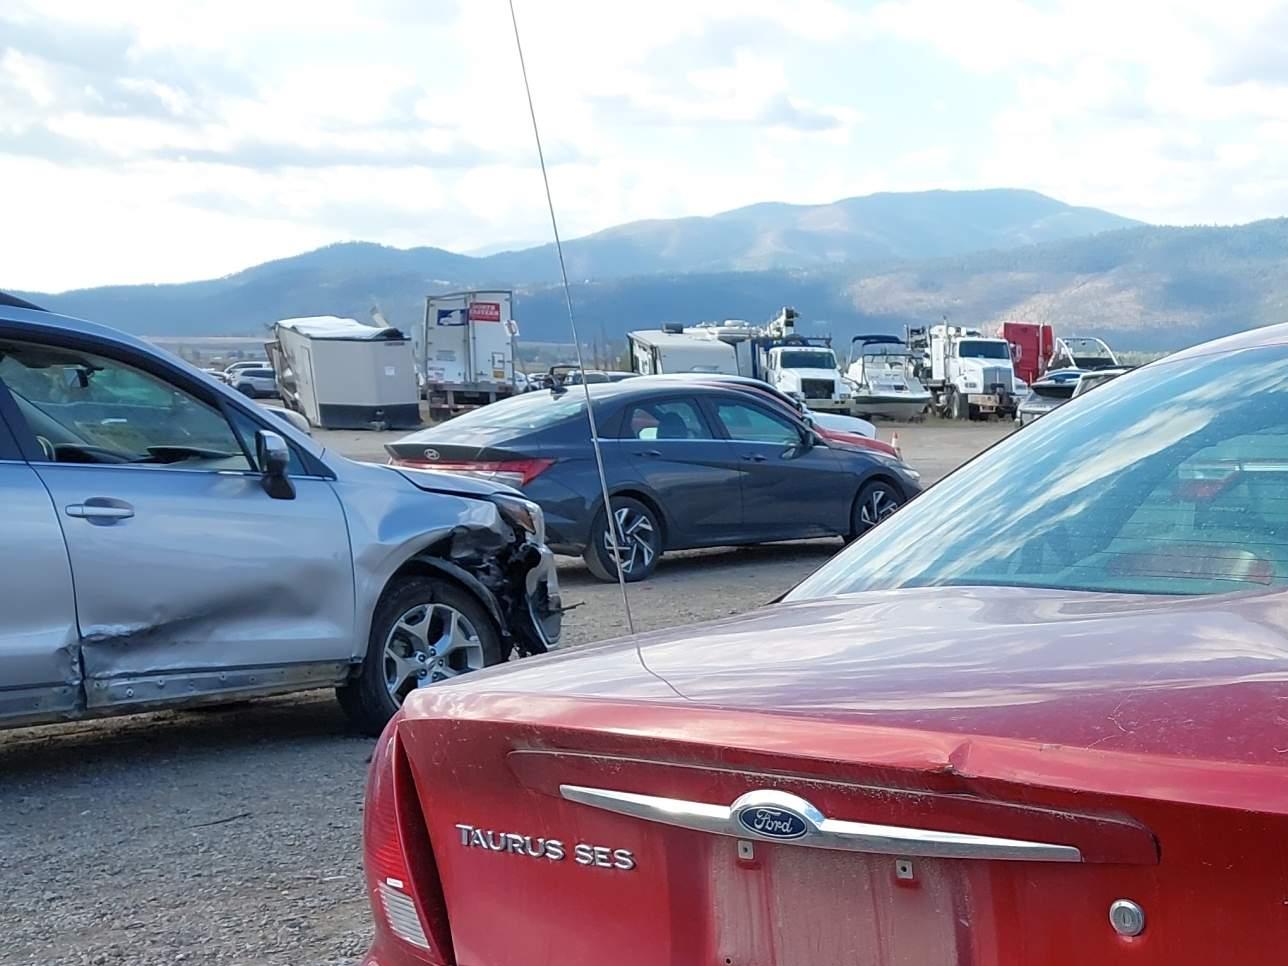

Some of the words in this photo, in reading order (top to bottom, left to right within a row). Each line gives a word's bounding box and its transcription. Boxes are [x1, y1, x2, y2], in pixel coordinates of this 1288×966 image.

[753, 808, 793, 833] Ford
[455, 823, 566, 861] TAURUS
[574, 843, 637, 871] SES
